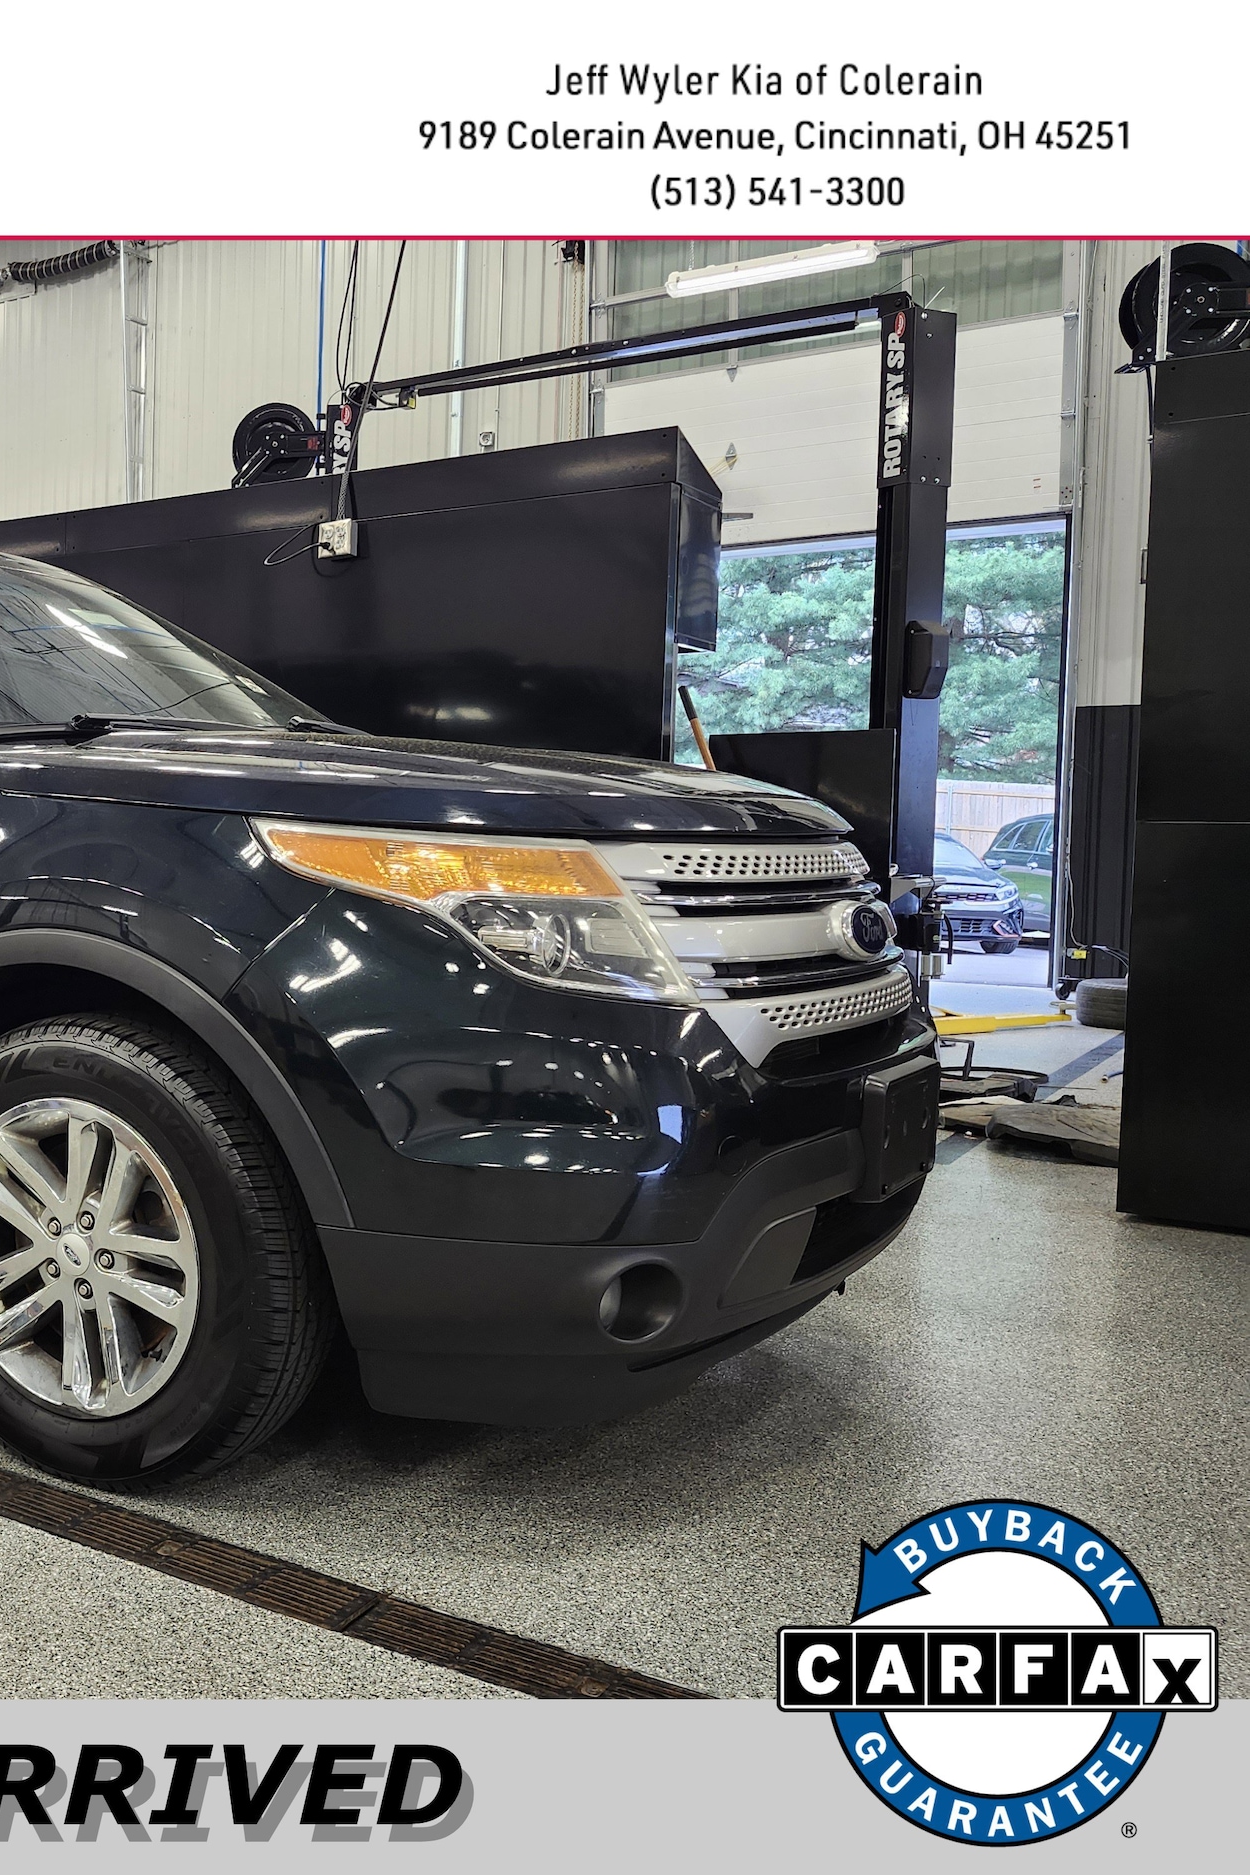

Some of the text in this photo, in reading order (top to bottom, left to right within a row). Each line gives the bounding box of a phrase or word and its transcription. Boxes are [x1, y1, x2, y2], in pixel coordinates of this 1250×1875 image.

[886, 332, 906, 369] SP
[333, 420, 352, 453] SP
[883, 372, 905, 479] ROTARY
